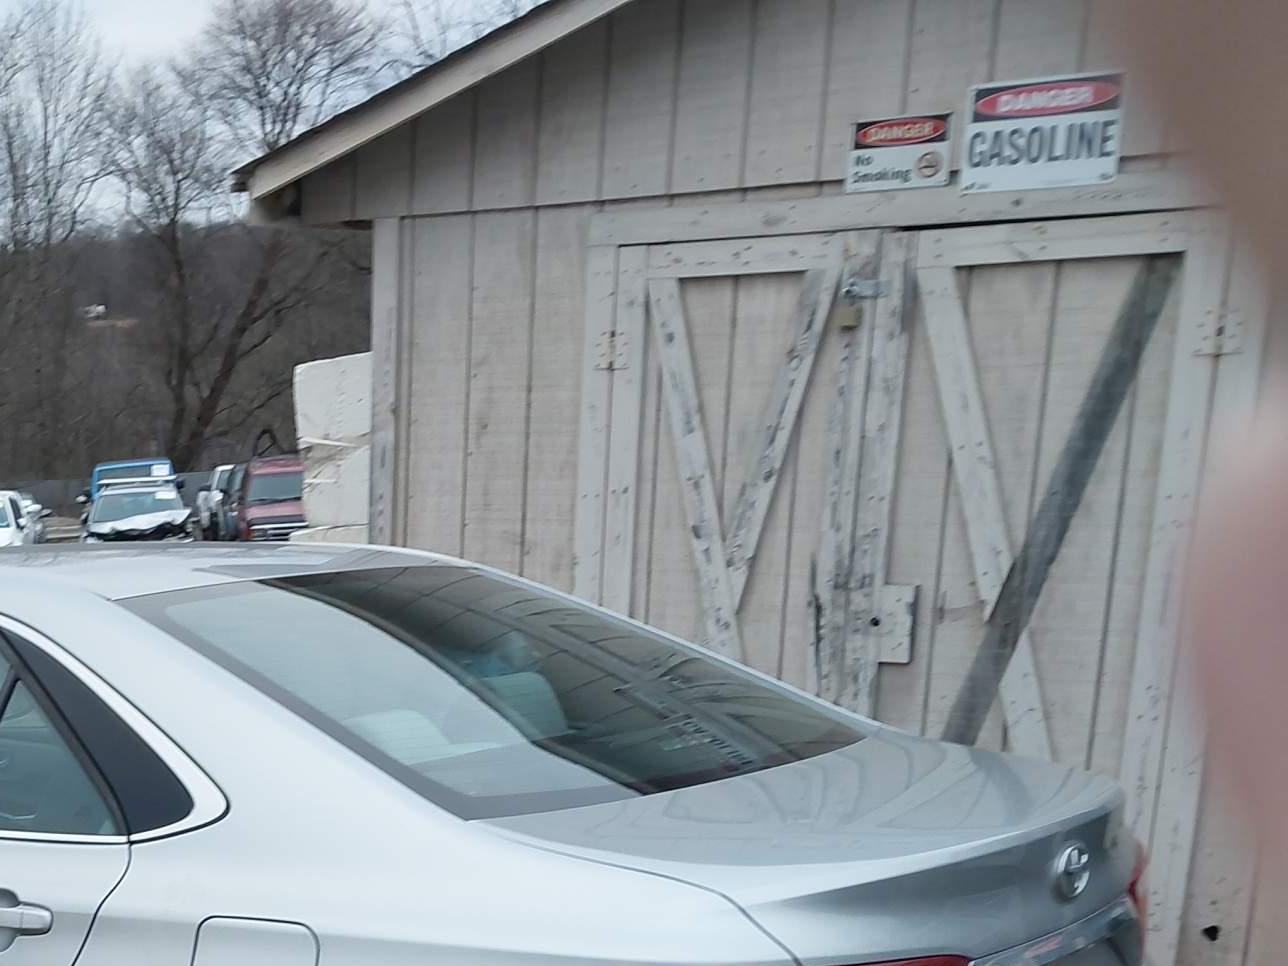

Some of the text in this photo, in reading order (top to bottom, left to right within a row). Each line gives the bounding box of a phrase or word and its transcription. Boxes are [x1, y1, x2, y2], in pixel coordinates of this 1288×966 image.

[995, 85, 1093, 114] DANGER
[865, 121, 935, 142] DANGER
[968, 119, 1118, 169] GASOLINE
[855, 155, 873, 167] No
[852, 168, 913, 184] Smoking
